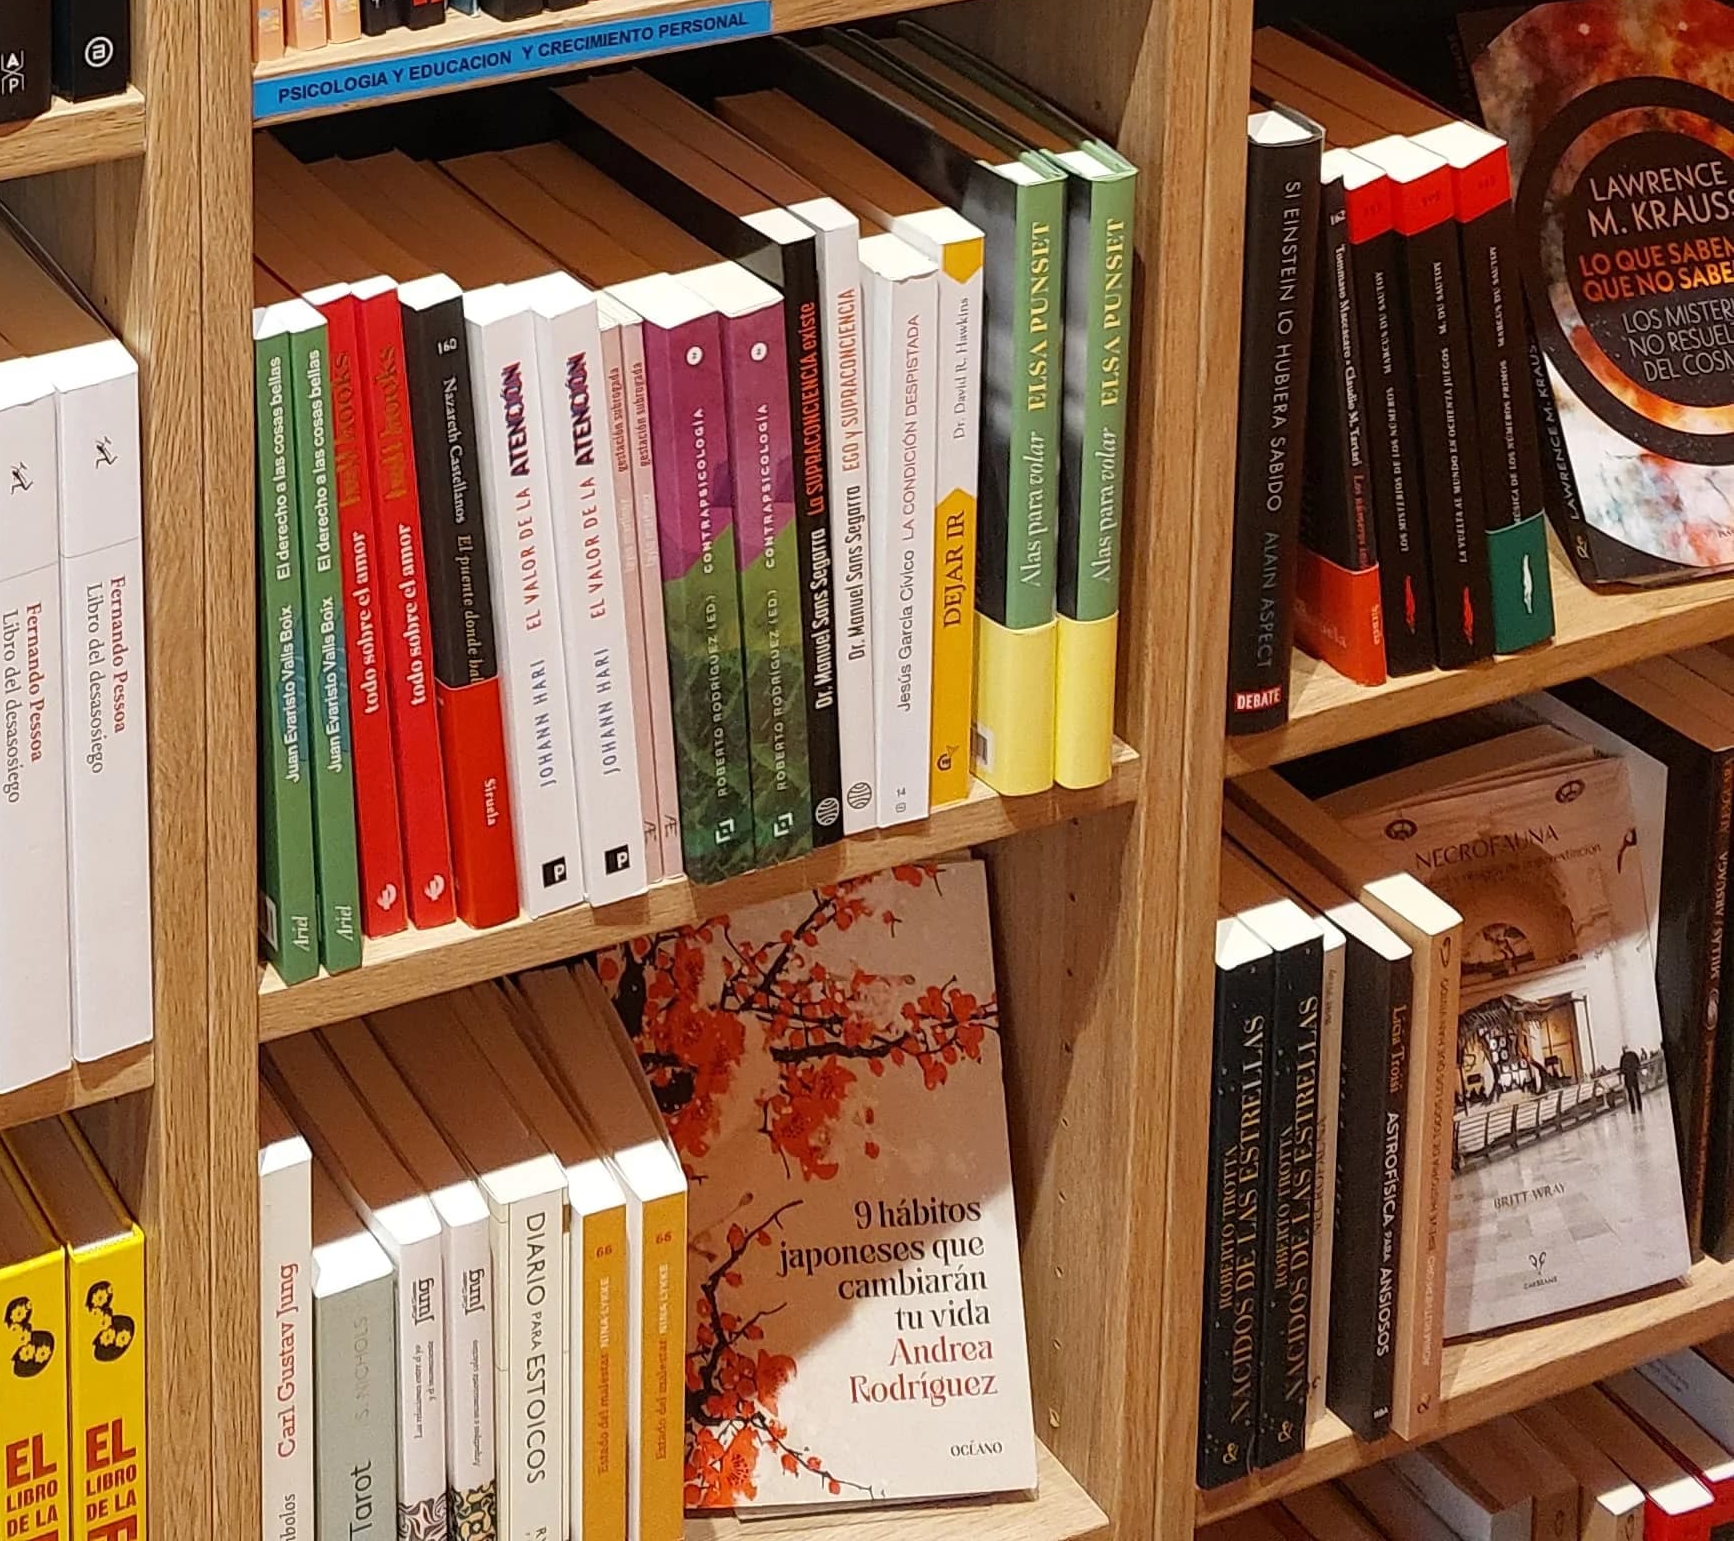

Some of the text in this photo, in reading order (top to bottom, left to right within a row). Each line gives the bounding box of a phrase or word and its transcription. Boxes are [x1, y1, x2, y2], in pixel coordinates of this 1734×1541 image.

[279, 12, 747, 102] PSICOLOGIA Y EDUCACION Y CRECIMIENTO PERSONAL
[1589, 161, 1727, 202] LAWRENCE
[1587, 206, 1627, 238] M.
[1266, 181, 1300, 510] SI EINSTEIN LO HUBIERA SABIDO
[1020, 222, 1049, 586] Alas para volar ELSA PUNSET
[943, 510, 966, 627] DEJAR IR
[110, 575, 128, 733] Fernando Pessoa
[86, 582, 107, 773] Libro del desasosiego
[1237, 688, 1279, 709] DEBATE
[854, 1196, 982, 1230] 9 hábitos
[776, 1235, 985, 1276] japoneses que
[837, 1266, 989, 1300] cambiarán
[896, 1300, 991, 1332] tu vida
[276, 1263, 298, 1457] Carl Gustav Jung
[889, 1337, 994, 1366] Andrea
[849, 1369, 998, 1407] Rodríguez
[85, 1418, 137, 1473] EL
[85, 1463, 137, 1497] LIBRO
[86, 1488, 137, 1522] DE LA
